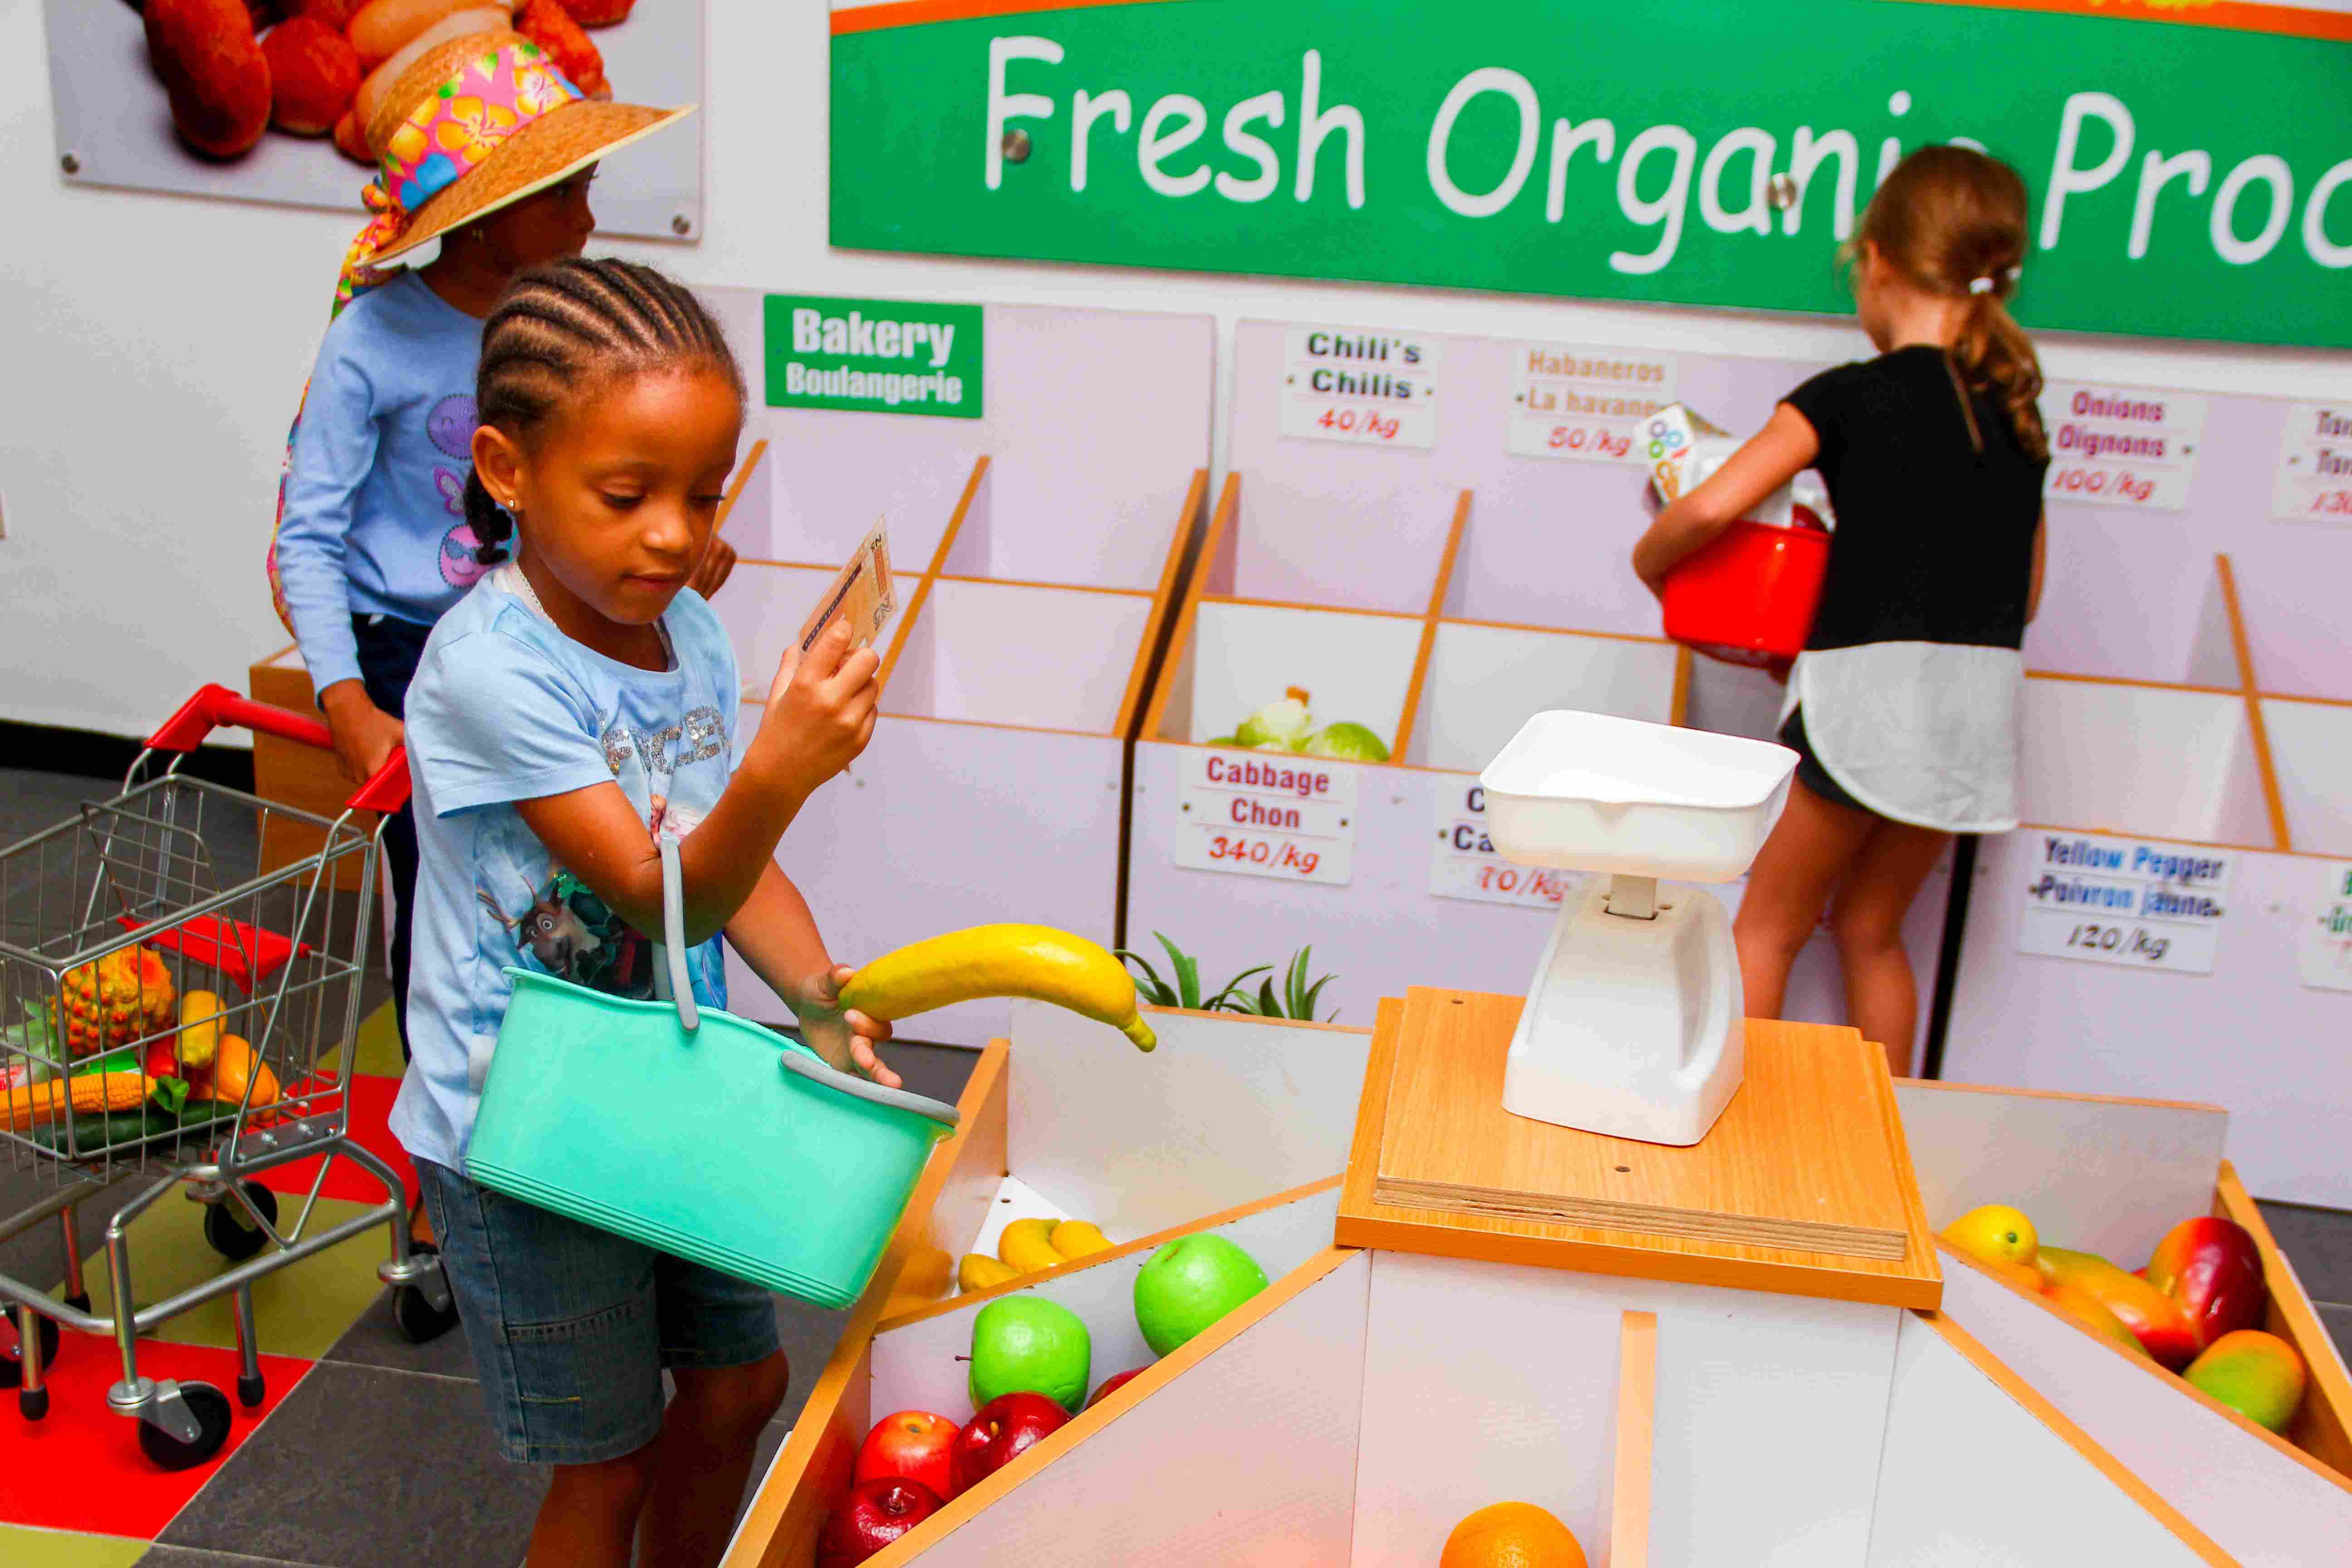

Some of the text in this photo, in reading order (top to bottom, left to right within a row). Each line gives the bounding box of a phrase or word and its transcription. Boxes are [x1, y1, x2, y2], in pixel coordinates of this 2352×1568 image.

[985, 35, 1366, 210] Fresh
[1426, 66, 1990, 274] Organi
[793, 308, 955, 368] Bakery
[1308, 332, 1421, 363] Chili's
[1528, 349, 1664, 381] Habaneros
[785, 361, 962, 405] Boulangerie
[1311, 368, 1411, 399] Chilis
[1528, 387, 1555, 410] La
[2072, 391, 2164, 422] Onions
[1317, 408, 1401, 439] 40/kg
[1547, 425, 1632, 457] 50/kg
[2057, 423, 2165, 459] Oignons
[2052, 469, 2156, 501] 100/kg
[1207, 756, 1329, 797] Cabbage
[1208, 836, 1320, 874] 340/kg
[2045, 836, 2224, 886] Yellow Pepper
[2038, 875, 2133, 908] Poivron
[2066, 924, 2171, 960] 120/kg
